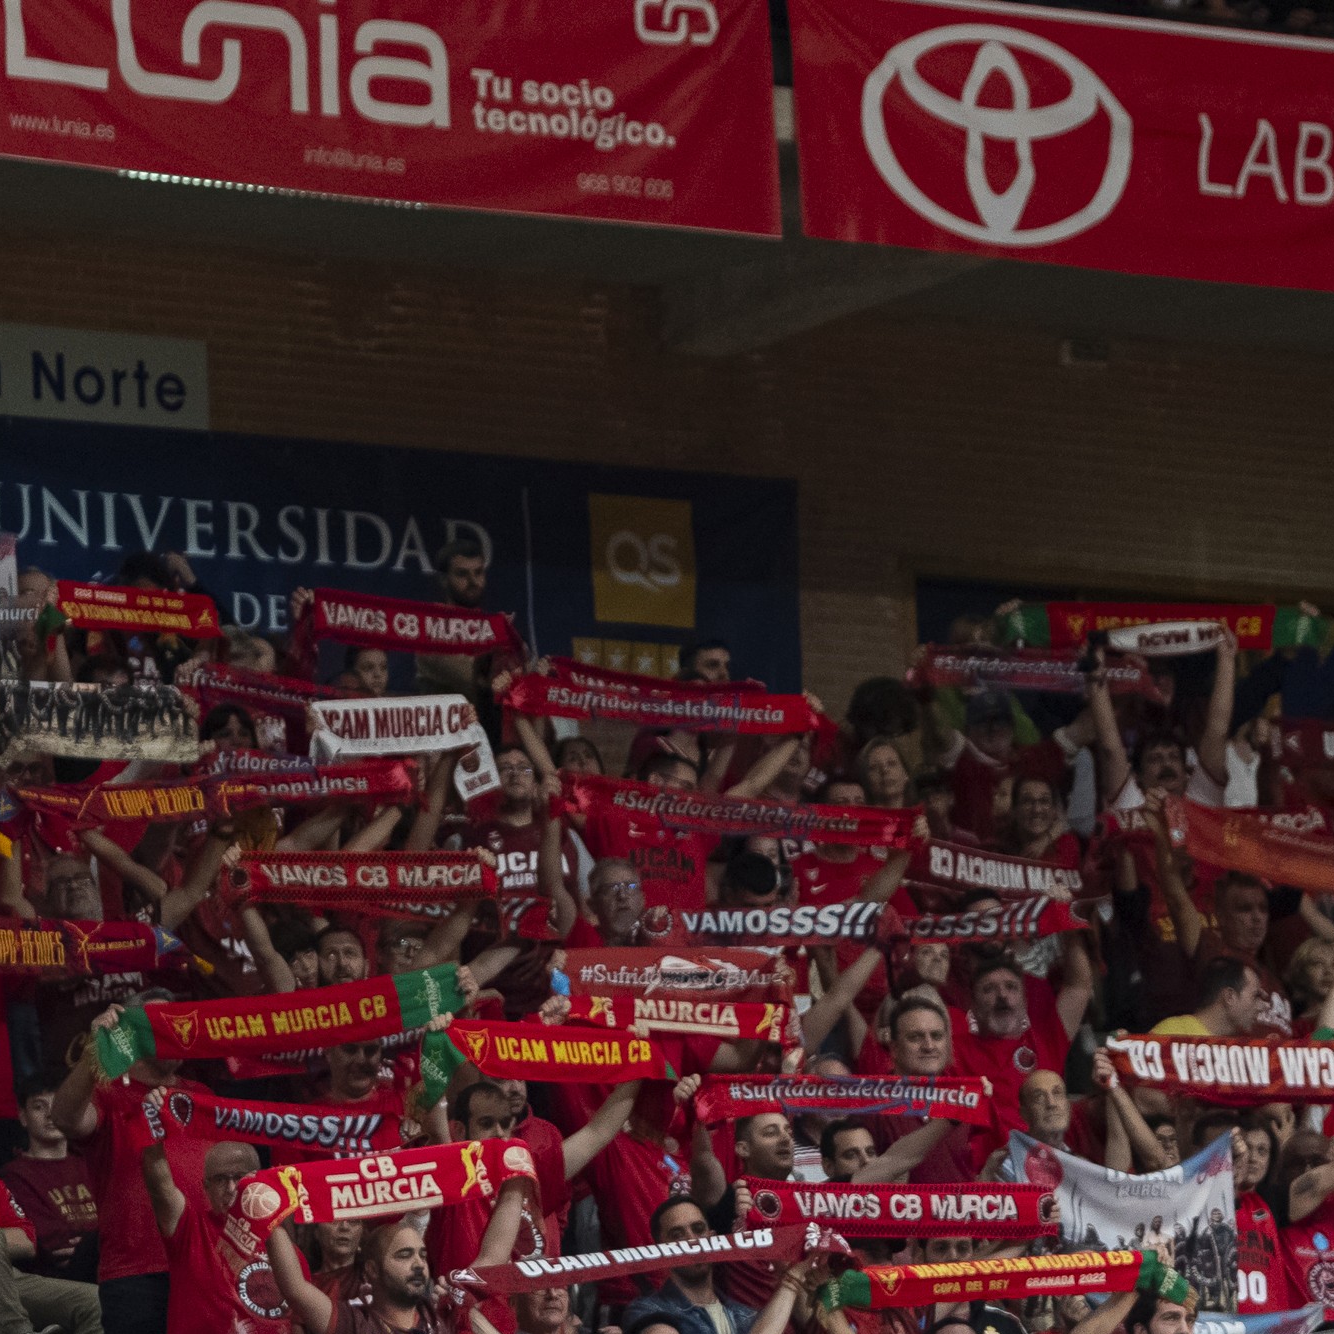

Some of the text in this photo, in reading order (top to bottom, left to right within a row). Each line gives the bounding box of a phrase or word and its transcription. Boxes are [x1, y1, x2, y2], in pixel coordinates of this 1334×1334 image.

[470, 68, 615, 111] Tu socio
[473, 106, 678, 150] tecnológico.
[31, 351, 187, 412] Norte
[605, 529, 682, 590] QS
[322, 600, 496, 643] VAMOS CB MURCIA
[261, 864, 482, 889] VAMOS CB MURCIA
[204, 994, 388, 1042] UCAM MURCIA CB
[494, 1036, 652, 1065] UCAM MURCIA CB
[1171, 1042, 1270, 1087] MURCIA
[728, 1081, 979, 1109] #Sufridoresdelcbmurcia
[213, 1105, 381, 1150] VAMOSSS!!!
[330, 1163, 442, 1211] MURCIA
[358, 1156, 395, 1181] CB
[793, 1191, 1018, 1221] VAMOS CB MURCIA
